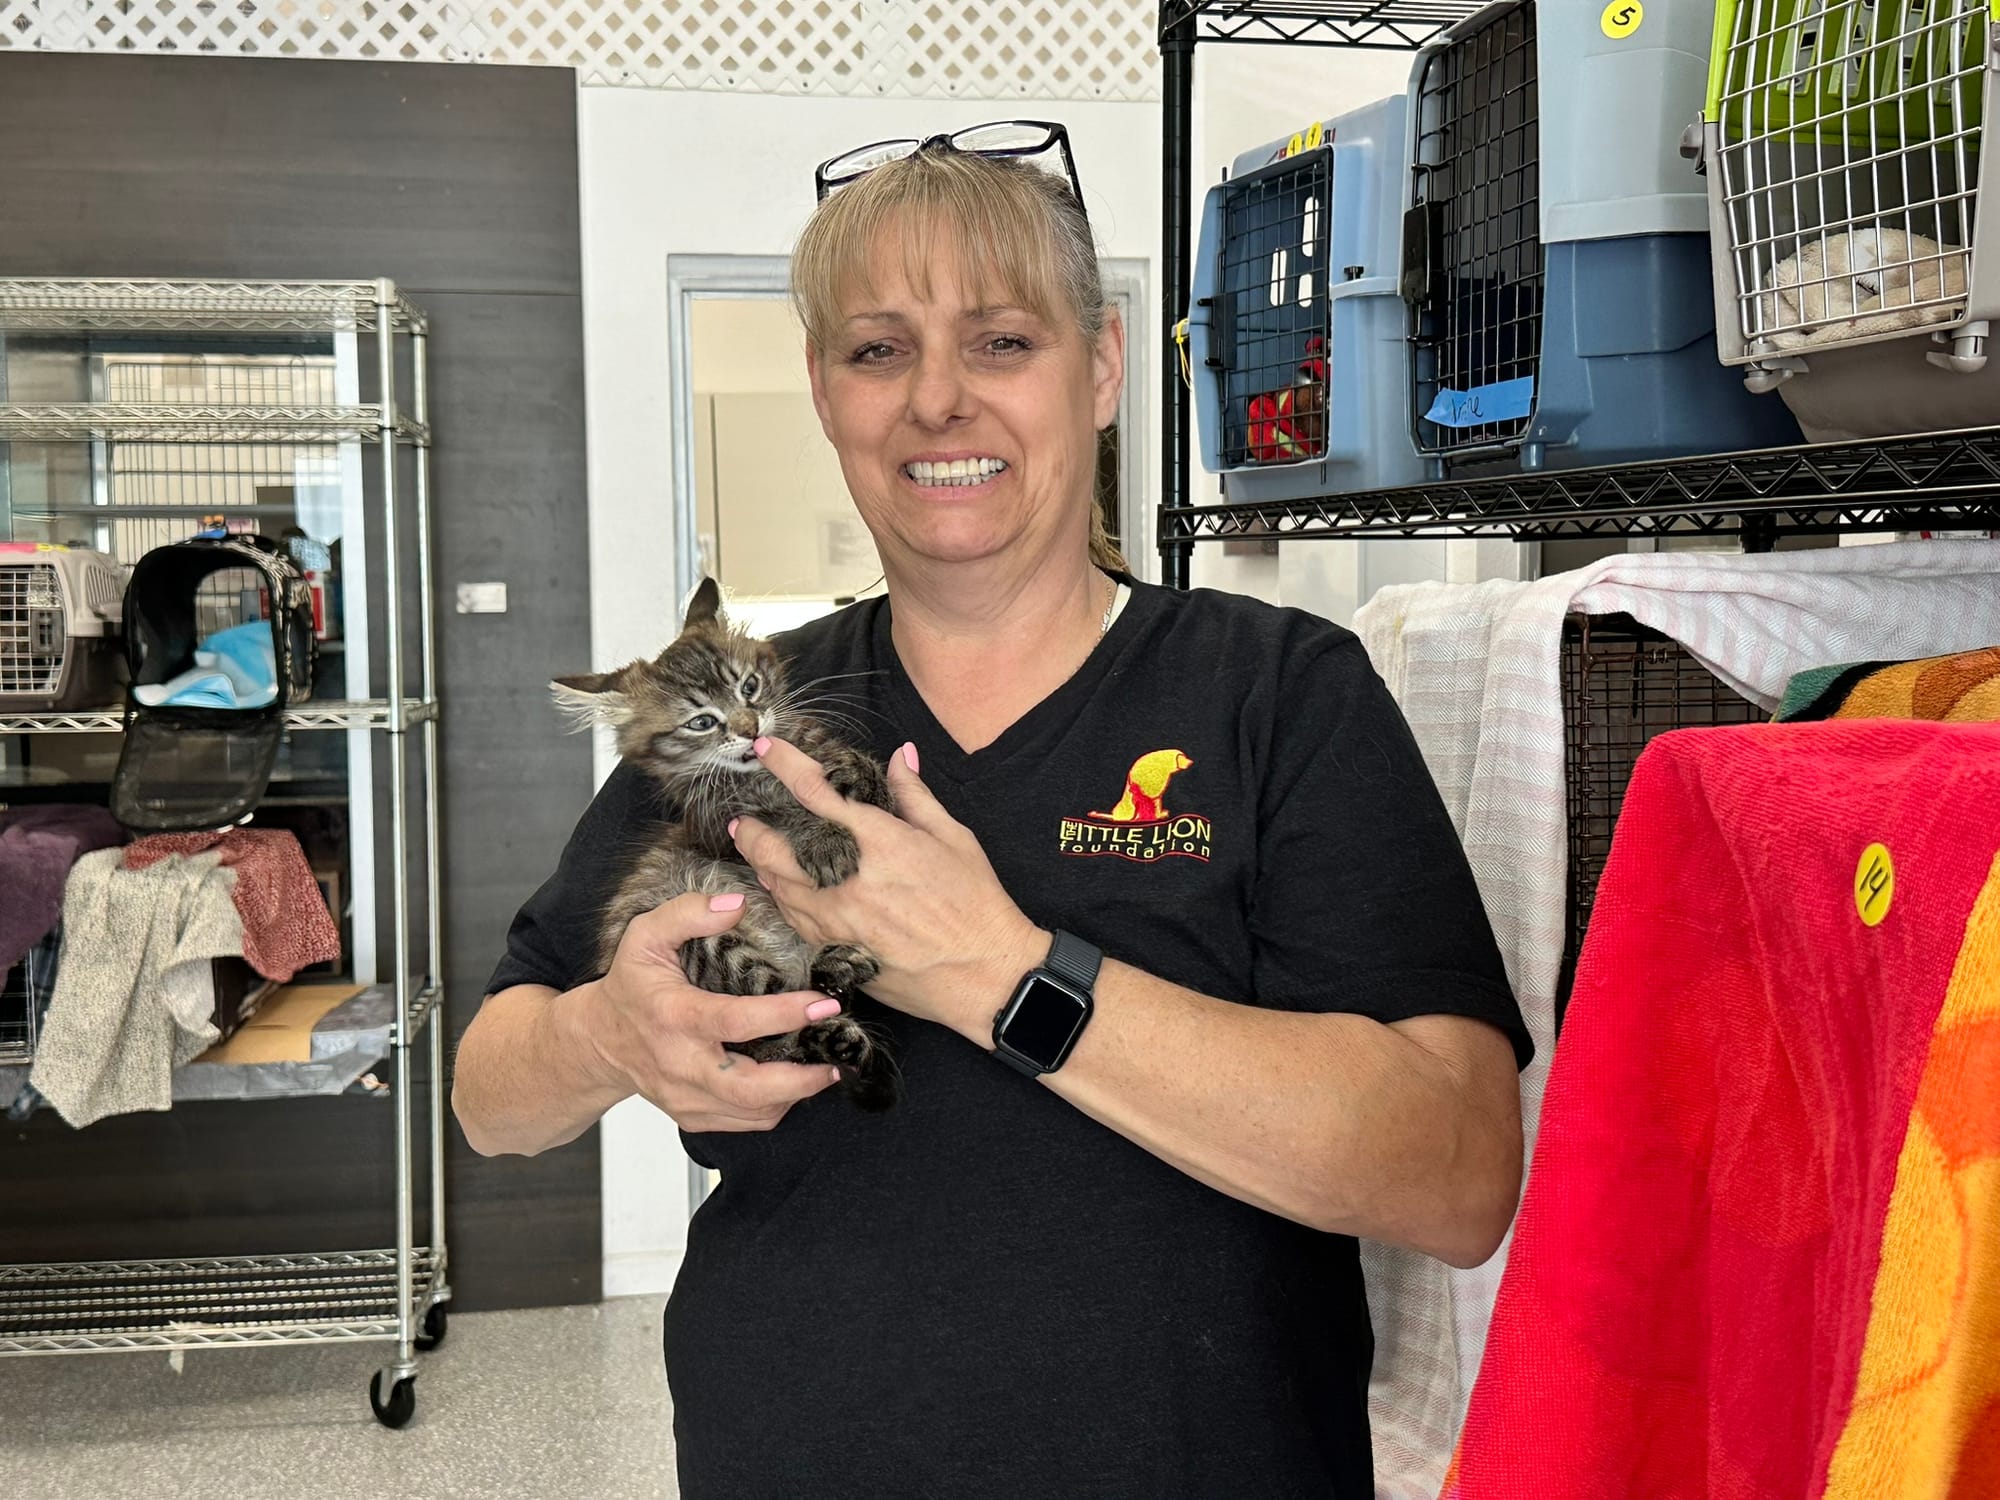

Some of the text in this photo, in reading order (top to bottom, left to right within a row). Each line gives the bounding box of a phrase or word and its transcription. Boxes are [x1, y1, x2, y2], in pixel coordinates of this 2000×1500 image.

[1611, 6, 1637, 26] 5
[1059, 817, 1211, 844] LITTLE LION
[1065, 821, 1078, 837] THE
[1059, 838, 1211, 859] foundation
[1858, 855, 1890, 912] 14
